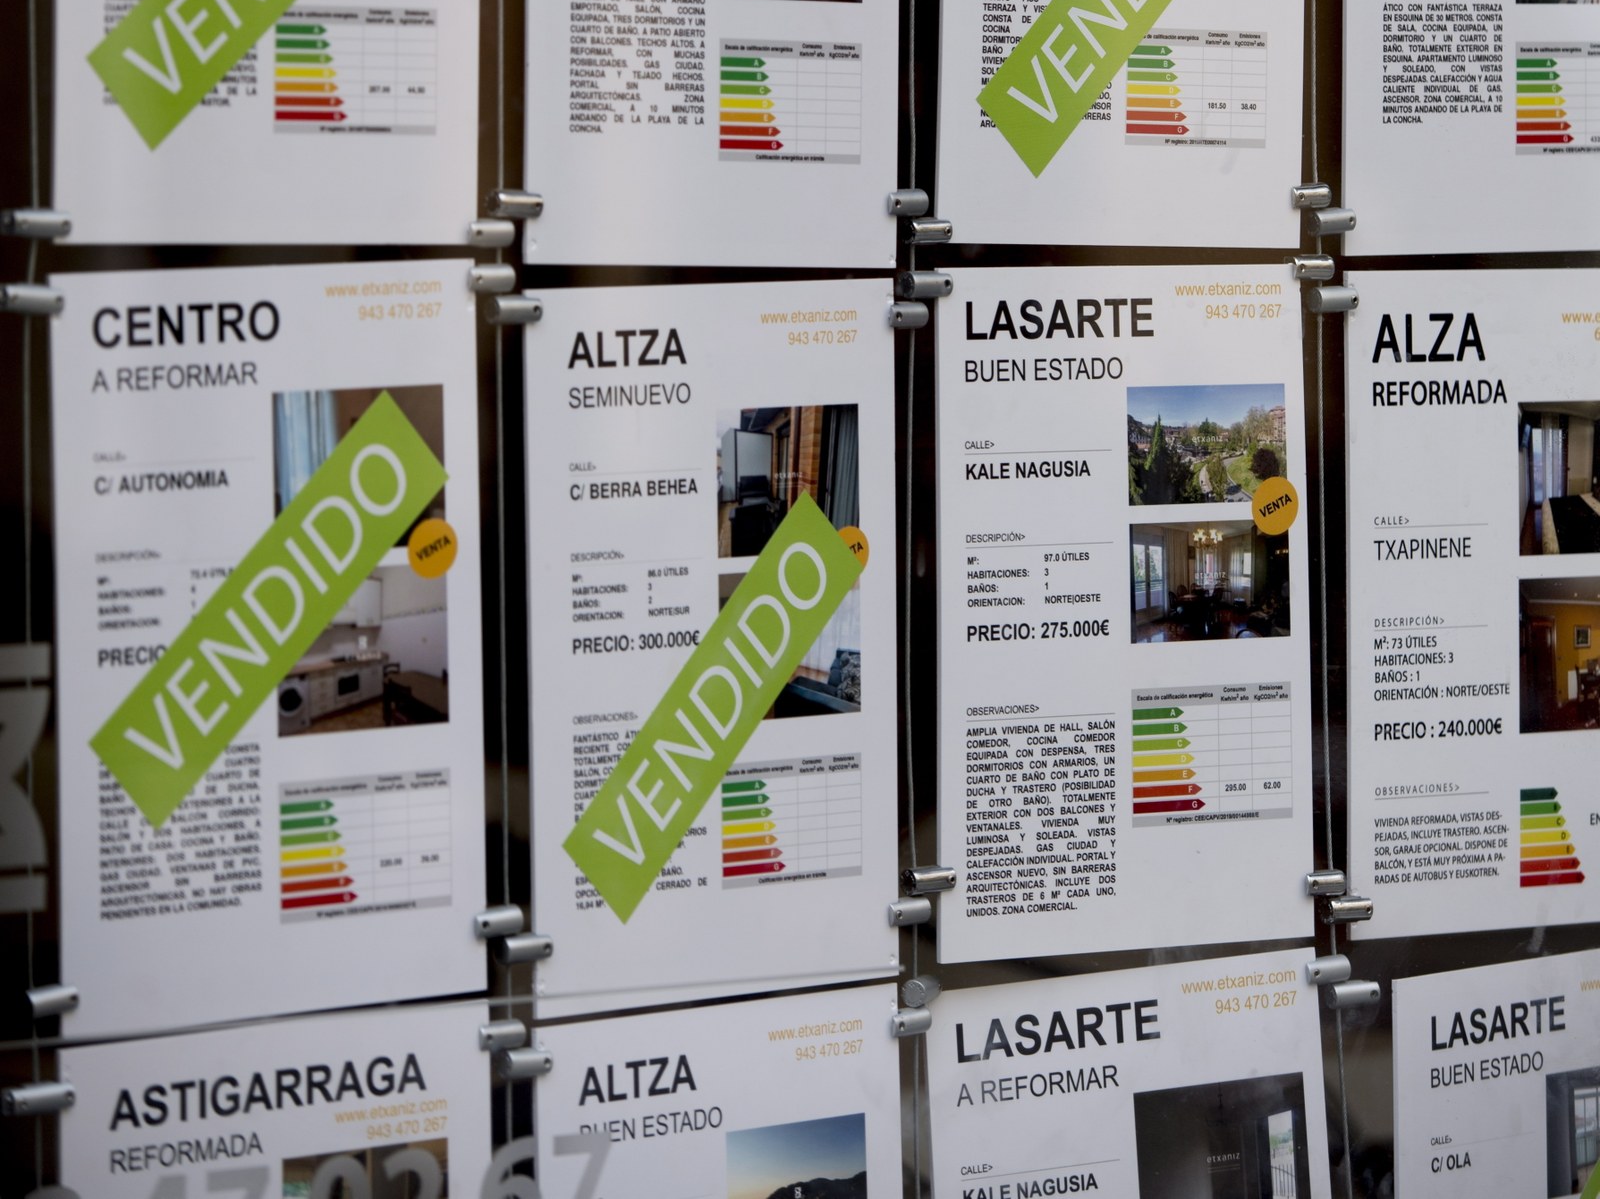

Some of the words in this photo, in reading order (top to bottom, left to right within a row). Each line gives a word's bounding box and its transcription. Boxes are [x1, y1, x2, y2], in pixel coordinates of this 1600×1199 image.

[1382, 2, 1404, 12] ÁTICO
[1407, 3, 1423, 12] CON
[1426, 2, 1468, 12] FANTÁSTICA
[1472, 3, 1503, 12] TERRAZA
[1174, 282, 1282, 297] www.etxaniz.com
[92, 300, 280, 349] CENTRO
[760, 309, 858, 324] www.etxaniz.com
[965, 297, 1155, 341] LASARTE
[1205, 304, 1229, 320] 943
[1231, 303, 1256, 319] 470
[1259, 303, 1282, 319] 267
[567, 328, 687, 370] ALTZA
[1371, 312, 1486, 364] ALZA
[91, 369, 110, 393] A
[116, 361, 258, 392] REFORMAR
[964, 358, 1026, 383] BUEN
[1034, 356, 1123, 382] ESTADO
[568, 382, 692, 410] SEMINUEVO
[1372, 379, 1508, 407] REFORMADA
[93, 475, 112, 496] C/
[119, 469, 229, 493] AUTONOMIA
[965, 462, 1011, 481] KALE
[1015, 459, 1091, 479] NAGUSIA
[569, 483, 585, 502] C/
[589, 481, 643, 500] BERRA
[646, 477, 698, 497] BEHEA
[1258, 492, 1293, 519] VENTA
[415, 534, 452, 562] VENTA
[1373, 536, 1472, 561] TXAPINENE
[967, 568, 1030, 580] HABITACIONES:
[123, 444, 408, 771] VENDIDO
[967, 596, 1025, 608] ORIENTACION:
[572, 633, 635, 655] PRECIO:
[638, 629, 704, 654] 300.000€
[967, 622, 1035, 643] PRECIO:
[1040, 618, 1110, 639] 275.000€
[1374, 651, 1446, 667] HABITACIONES:
[1448, 651, 1454, 664] 3
[592, 541, 827, 866] VENDIDO
[1374, 721, 1427, 741] PRECIO
[1438, 717, 1503, 738] 240.000€
[1224, 782, 1247, 792] 295.00
[1263, 780, 1282, 790] 62.00
[1181, 970, 1297, 998] www.etxaniz.com
[767, 1019, 864, 1046] www.etxaniz.com
[955, 998, 1161, 1064] LASARTE
[1431, 995, 1566, 1052] LASARTE
[578, 1054, 697, 1107] ALTZA
[1430, 1062, 1475, 1089] BUEN
[1479, 1050, 1544, 1081] ESTADO
[108, 1053, 427, 1132] ASTIGARRAGA
[956, 1083, 974, 1108] A
[981, 1064, 1120, 1104] REFORMAR
[642, 1106, 723, 1139] ESTADO
[109, 1132, 264, 1175] REFORMADA
[1430, 1156, 1444, 1174] C/
[1446, 1151, 1472, 1171] OLA
[962, 1184, 1012, 1199] KALE
[1016, 1172, 1099, 1199] NAGUSIA
